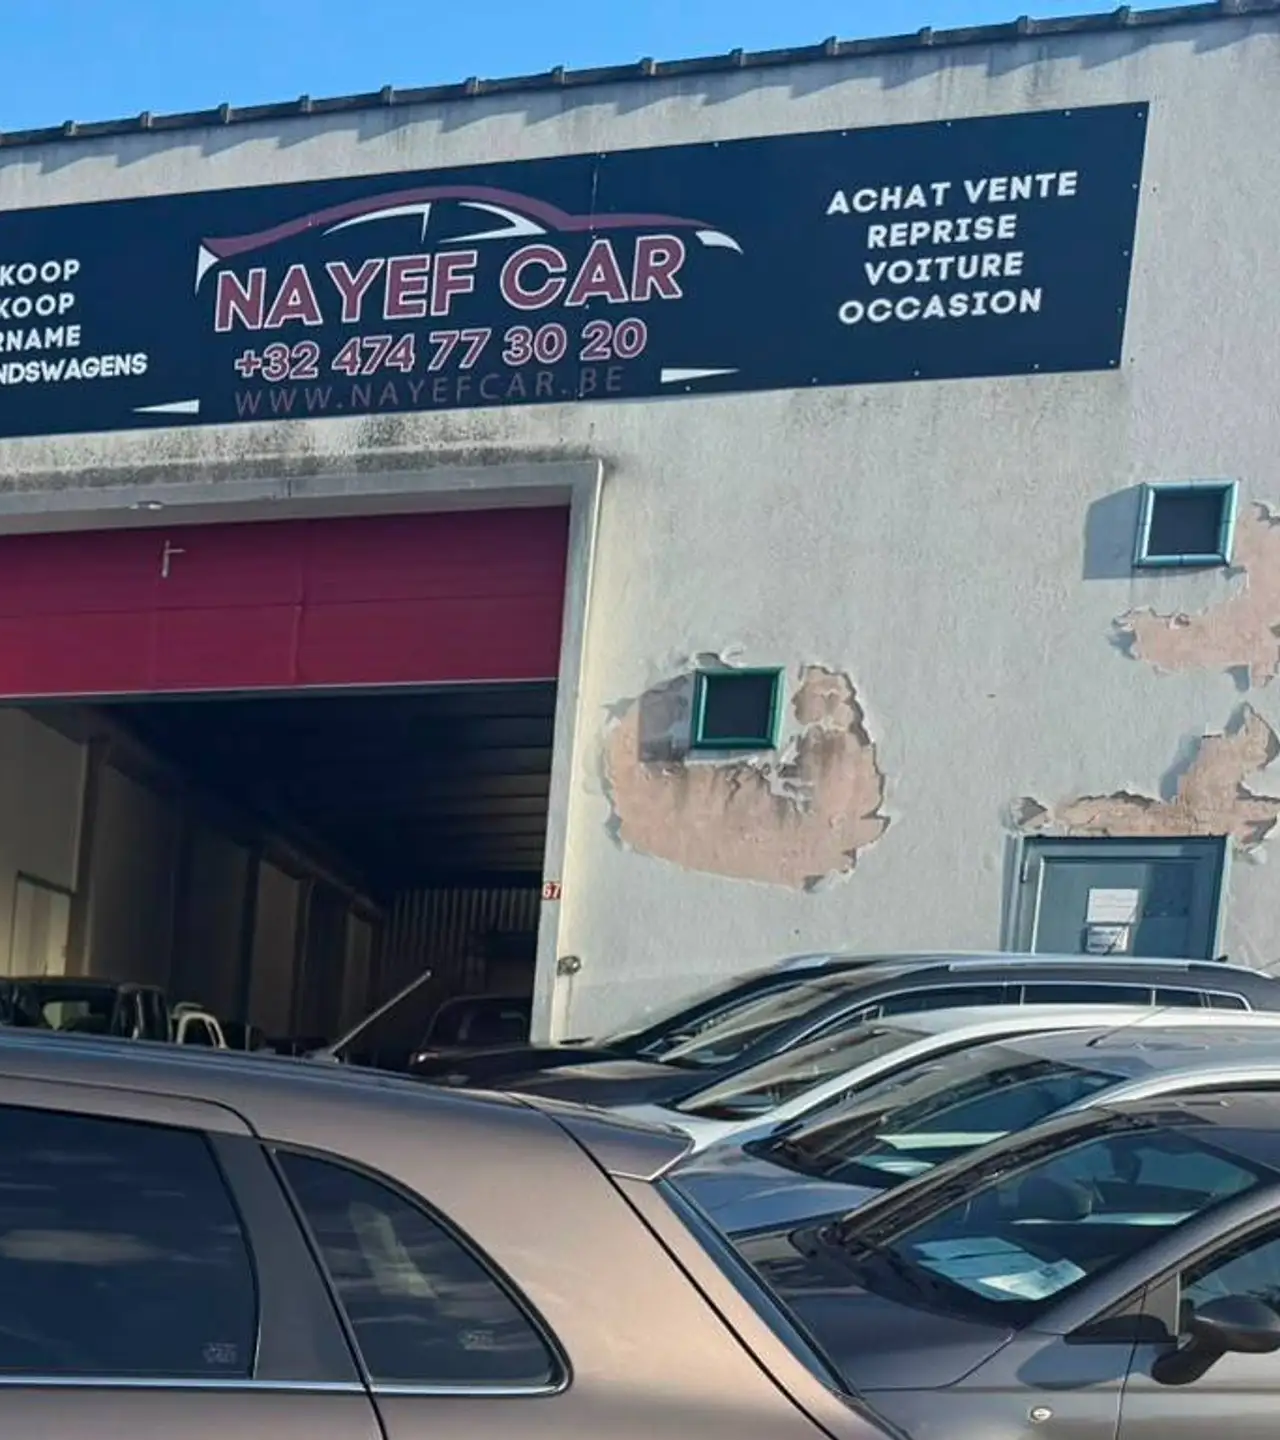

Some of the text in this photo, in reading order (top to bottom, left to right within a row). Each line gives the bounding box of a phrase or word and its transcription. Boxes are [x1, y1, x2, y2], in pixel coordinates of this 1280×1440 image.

[826, 171, 1078, 215] ACHAT VENTE
[867, 214, 1017, 249] REPRISE
[215, 234, 686, 332] NAYEF CAR
[864, 251, 1024, 286] VOITURE
[838, 287, 1042, 325] OCCASION
[234, 318, 648, 381] +32 474 77 30 20
[234, 366, 624, 416] WWW.NAYEFCAR.BE
